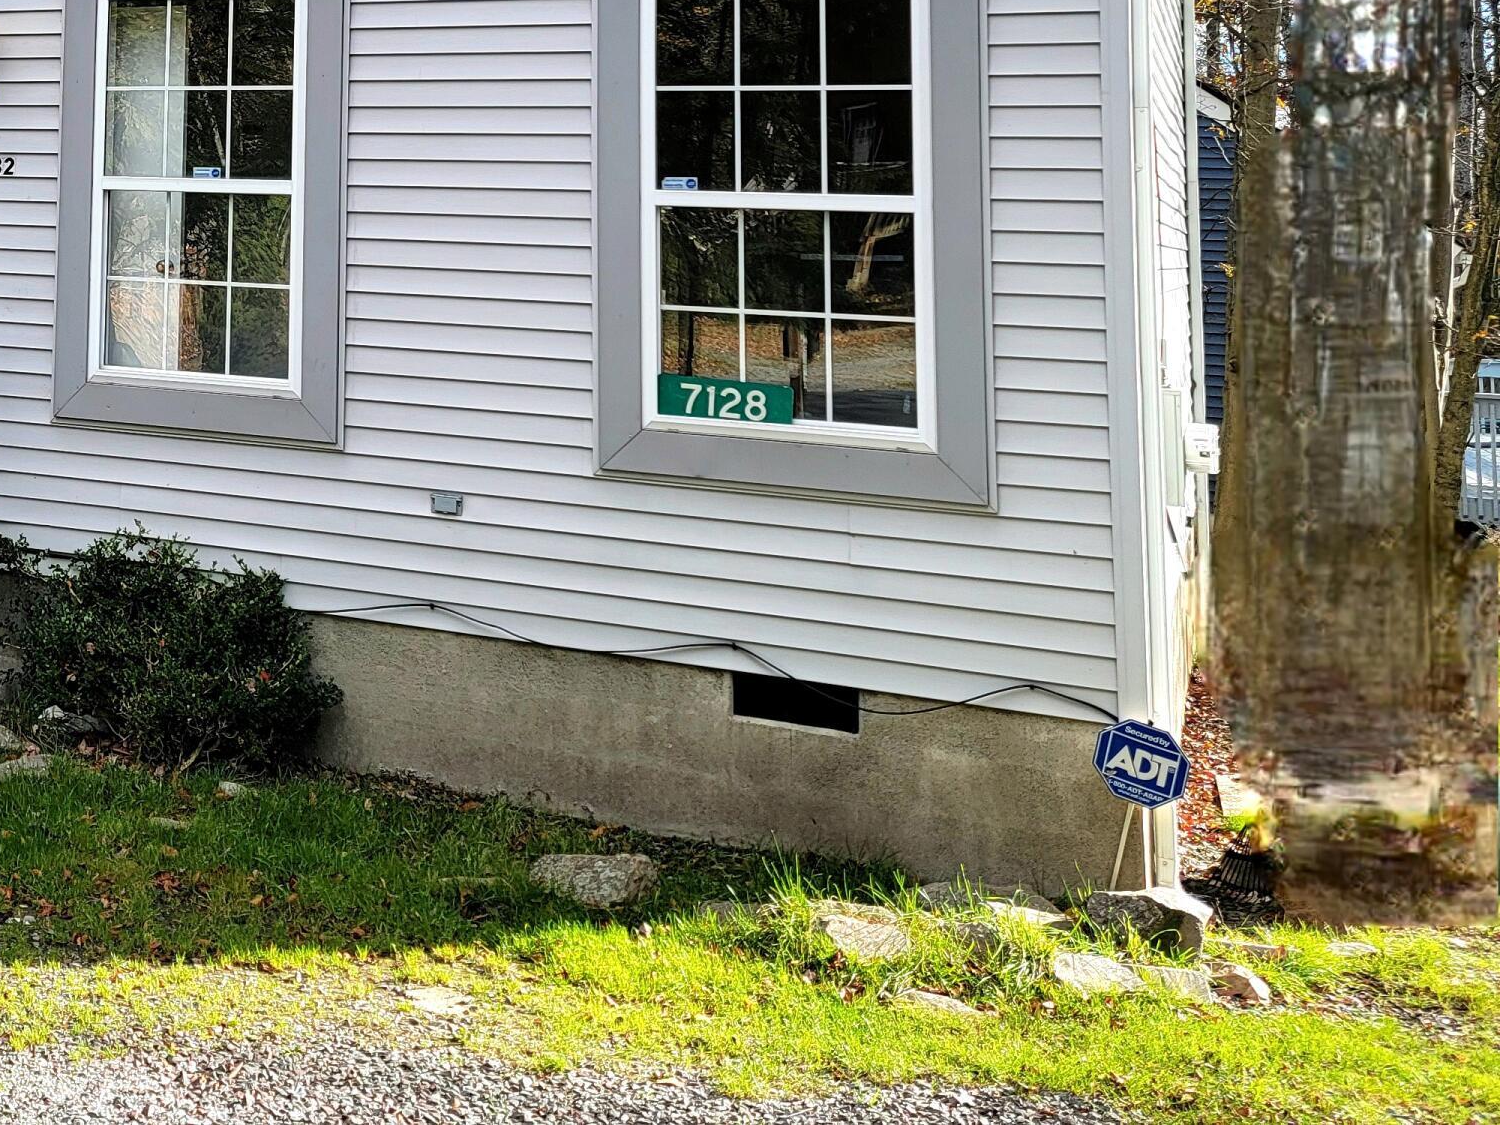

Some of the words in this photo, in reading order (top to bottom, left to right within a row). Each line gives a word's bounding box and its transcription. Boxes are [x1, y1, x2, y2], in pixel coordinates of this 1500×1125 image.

[679, 382, 767, 421] 7128
[1124, 725, 1159, 743] Secured
[1159, 738, 1170, 748] by
[1106, 744, 1178, 788] ADT
